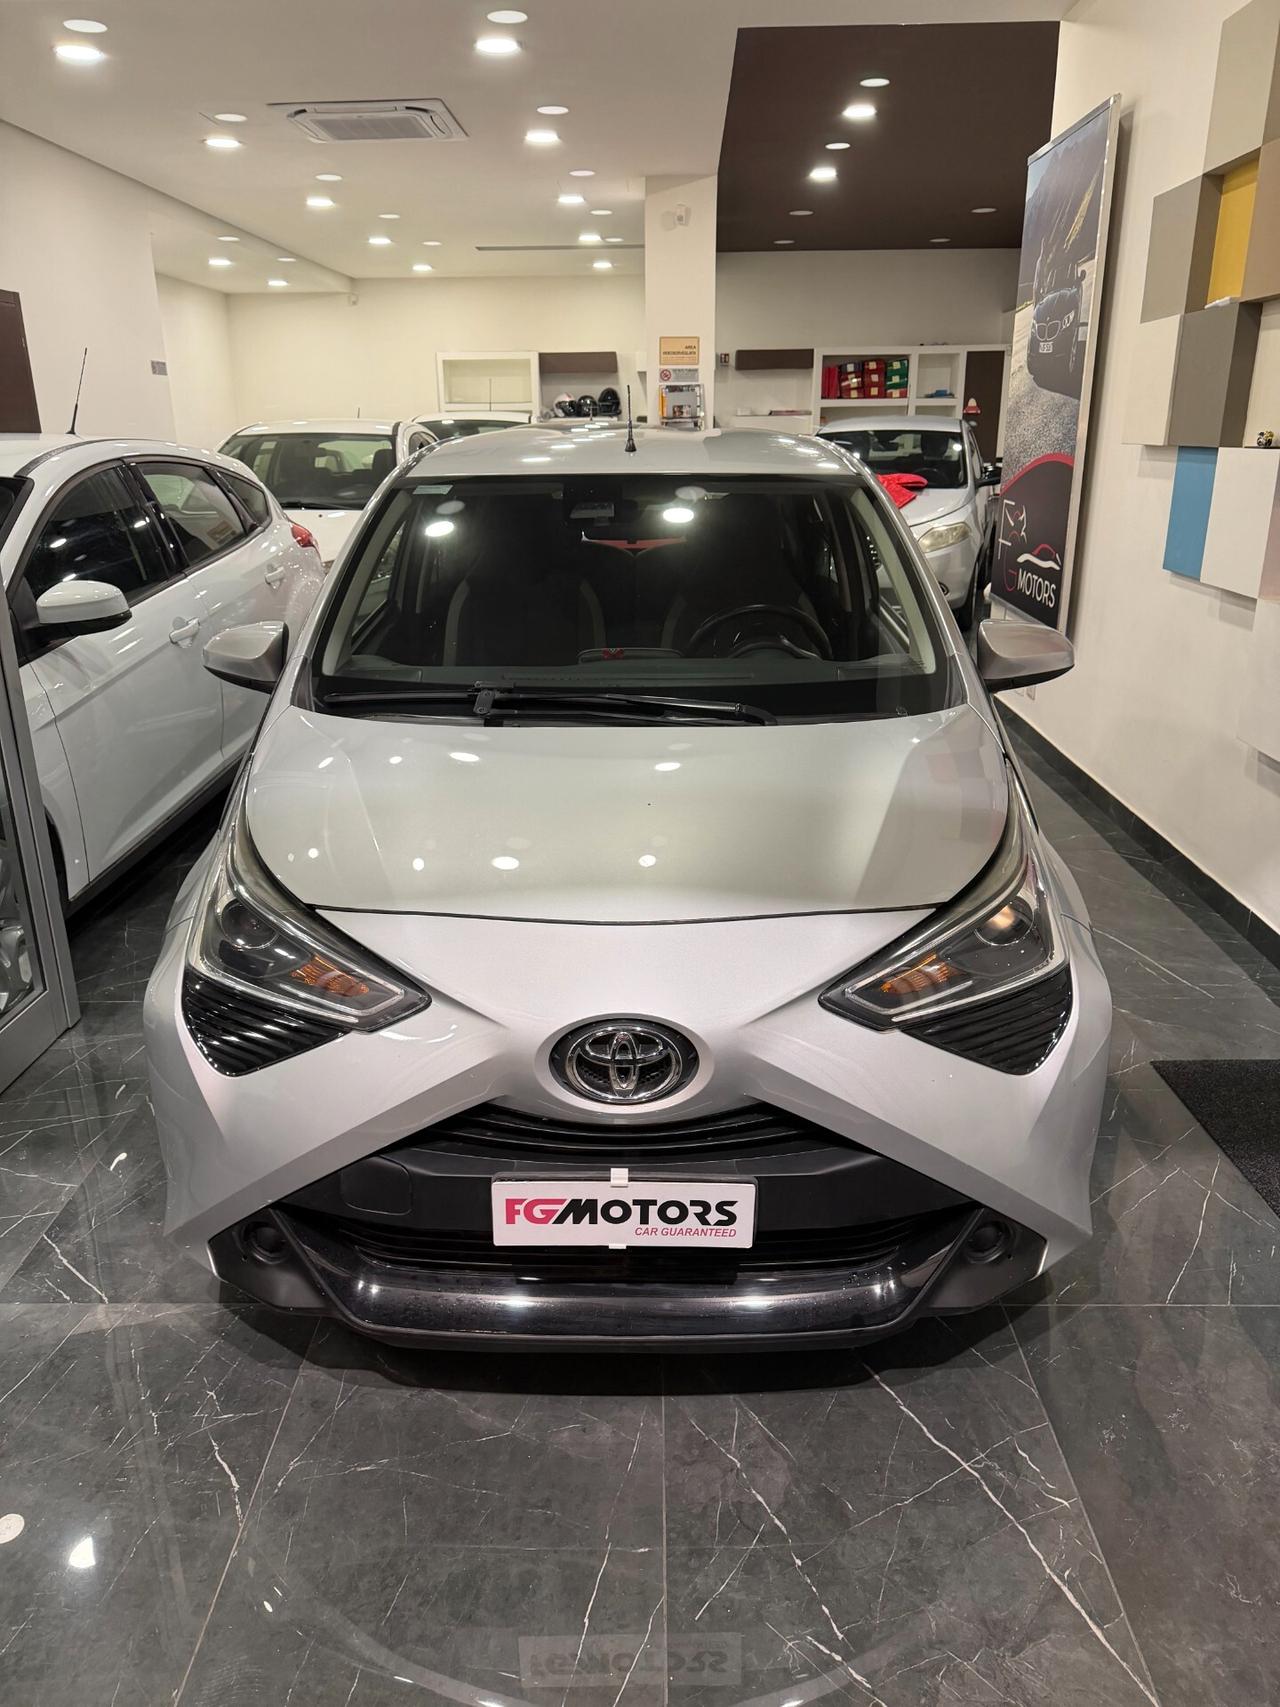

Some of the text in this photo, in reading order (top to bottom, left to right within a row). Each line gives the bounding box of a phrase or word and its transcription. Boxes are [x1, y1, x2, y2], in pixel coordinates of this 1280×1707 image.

[1017, 567, 1057, 608] MOTORS
[634, 1227, 737, 1238] CAR GUARANTEED
